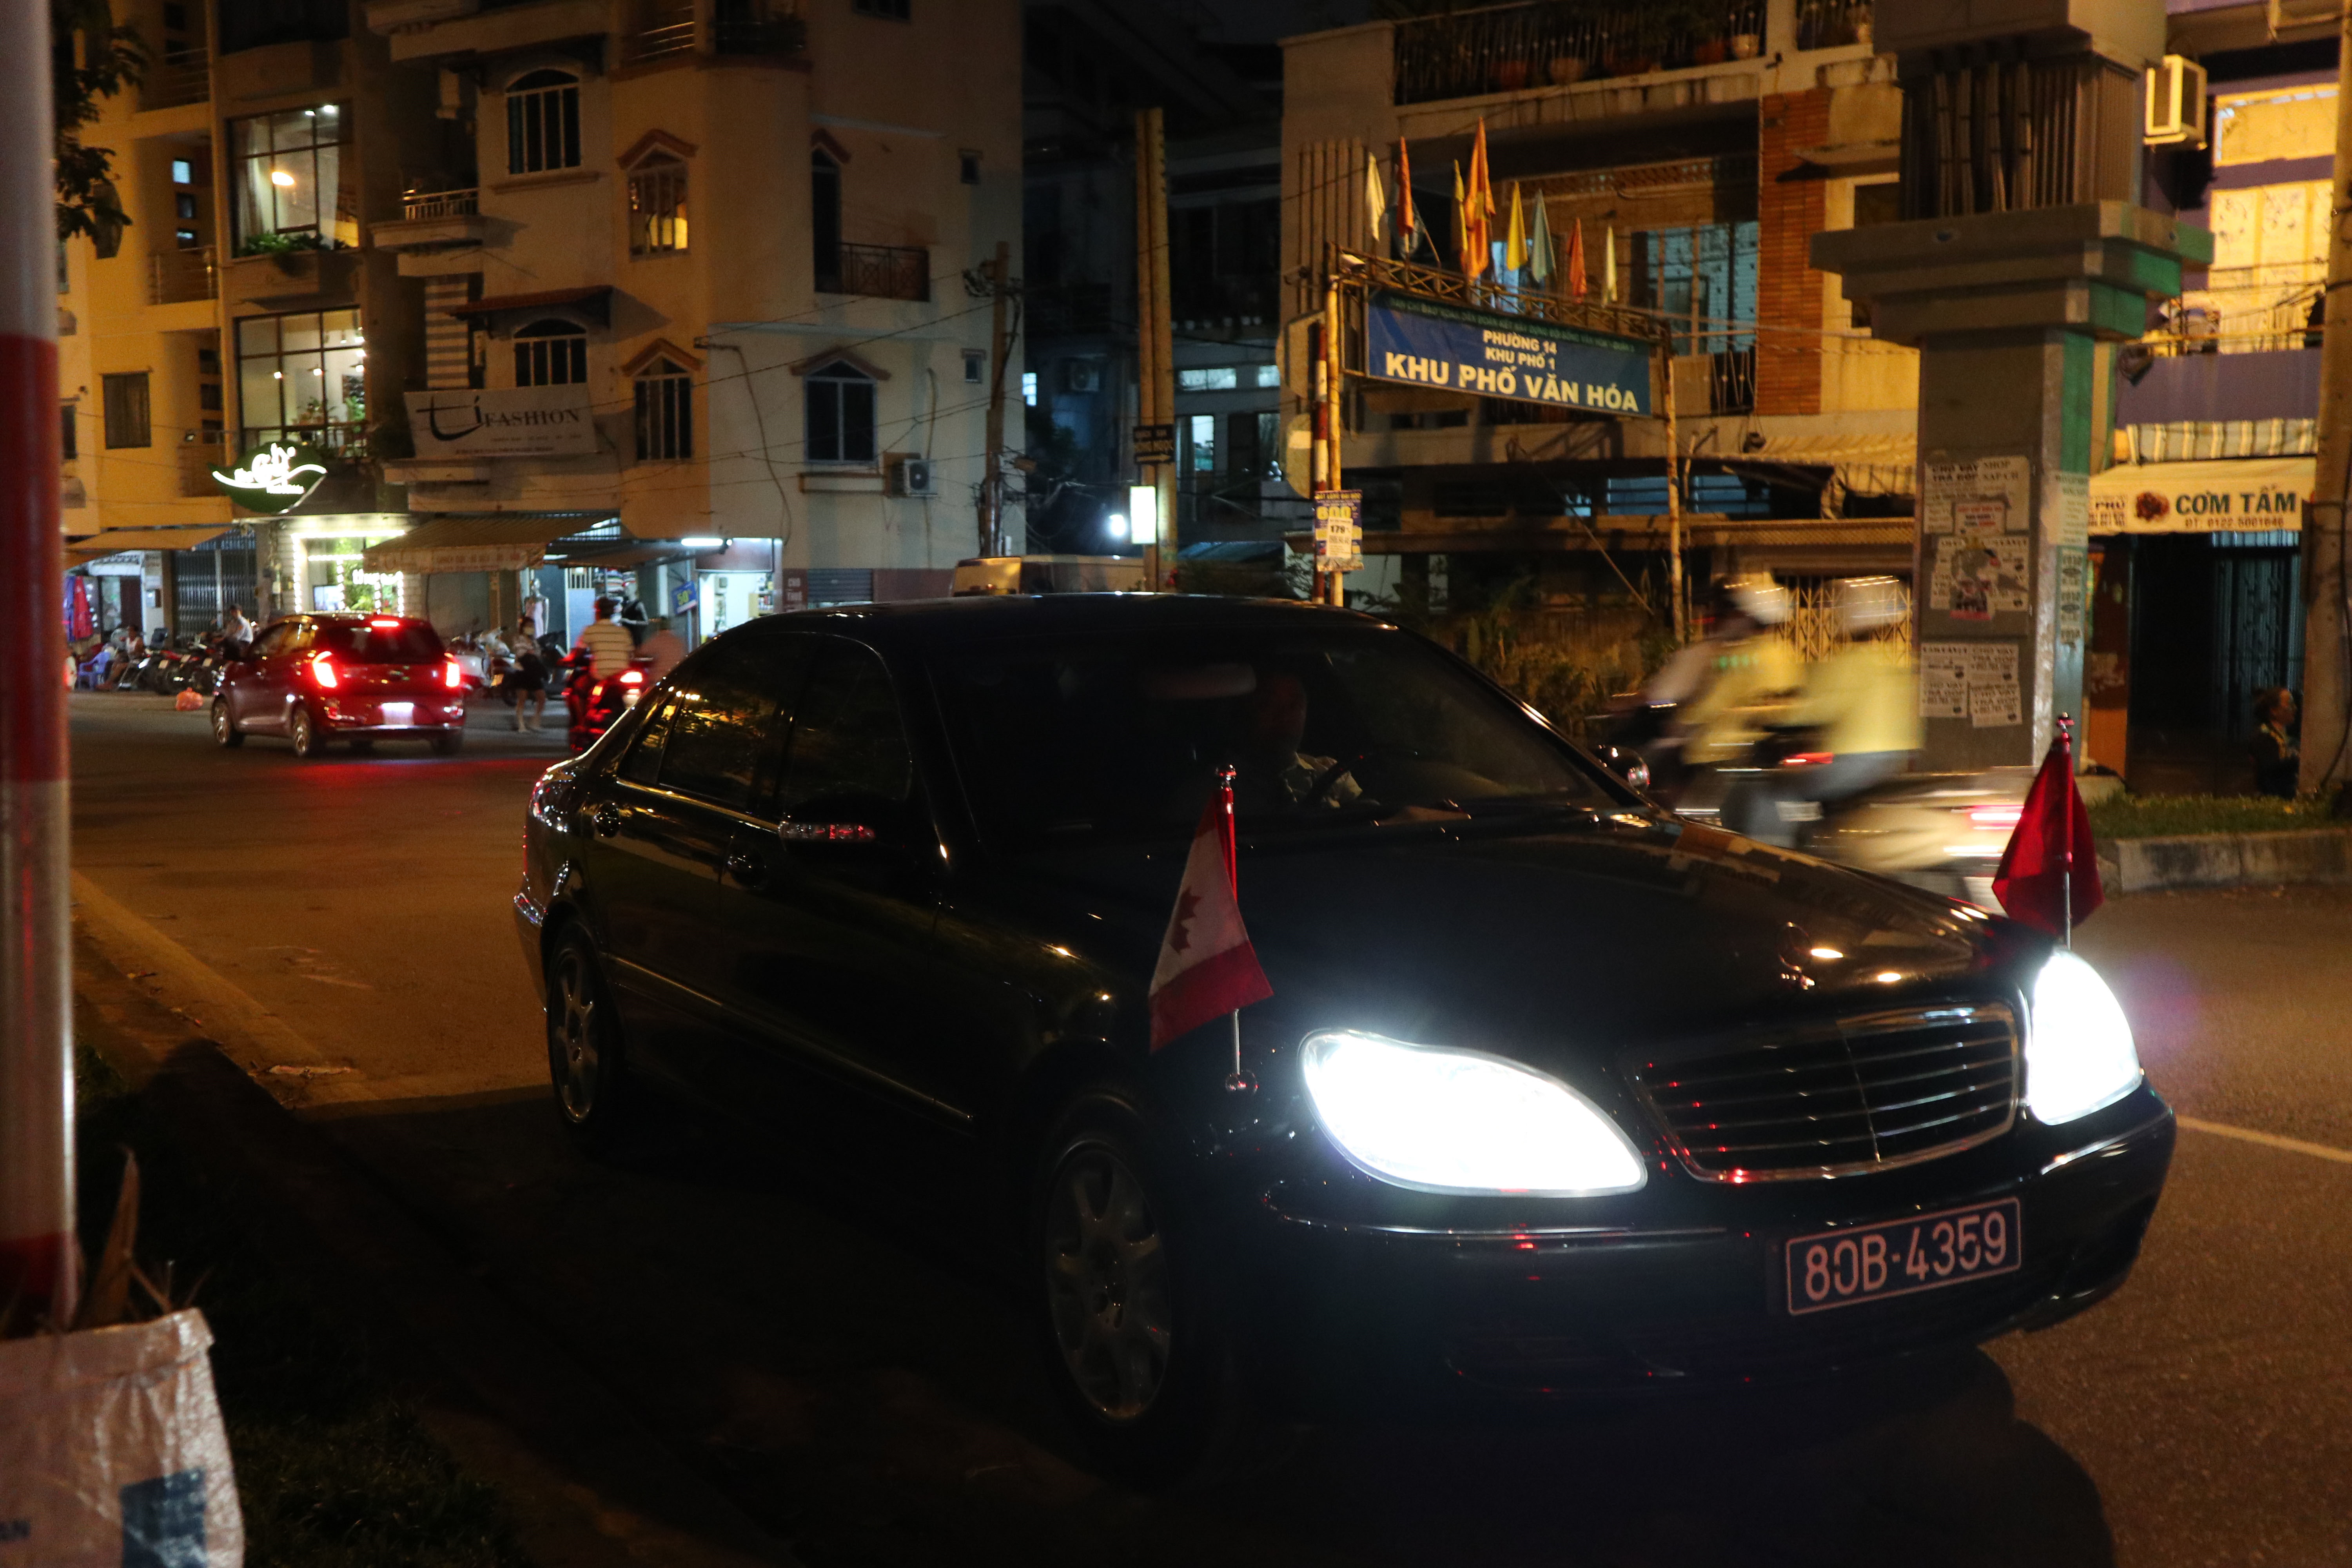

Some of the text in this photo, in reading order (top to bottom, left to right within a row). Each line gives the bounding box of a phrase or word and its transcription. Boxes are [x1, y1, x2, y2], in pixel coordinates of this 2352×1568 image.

[1485, 346, 1556, 370] KHU PHỐ 1
[1543, 340, 1558, 355] 14
[1385, 352, 1639, 412] KHU PHỐ VĂN HÓA
[484, 408, 579, 427] FASHION
[2176, 483, 2296, 515] CƠM TẤM
[1805, 1210, 2007, 1301] 80B-4359
